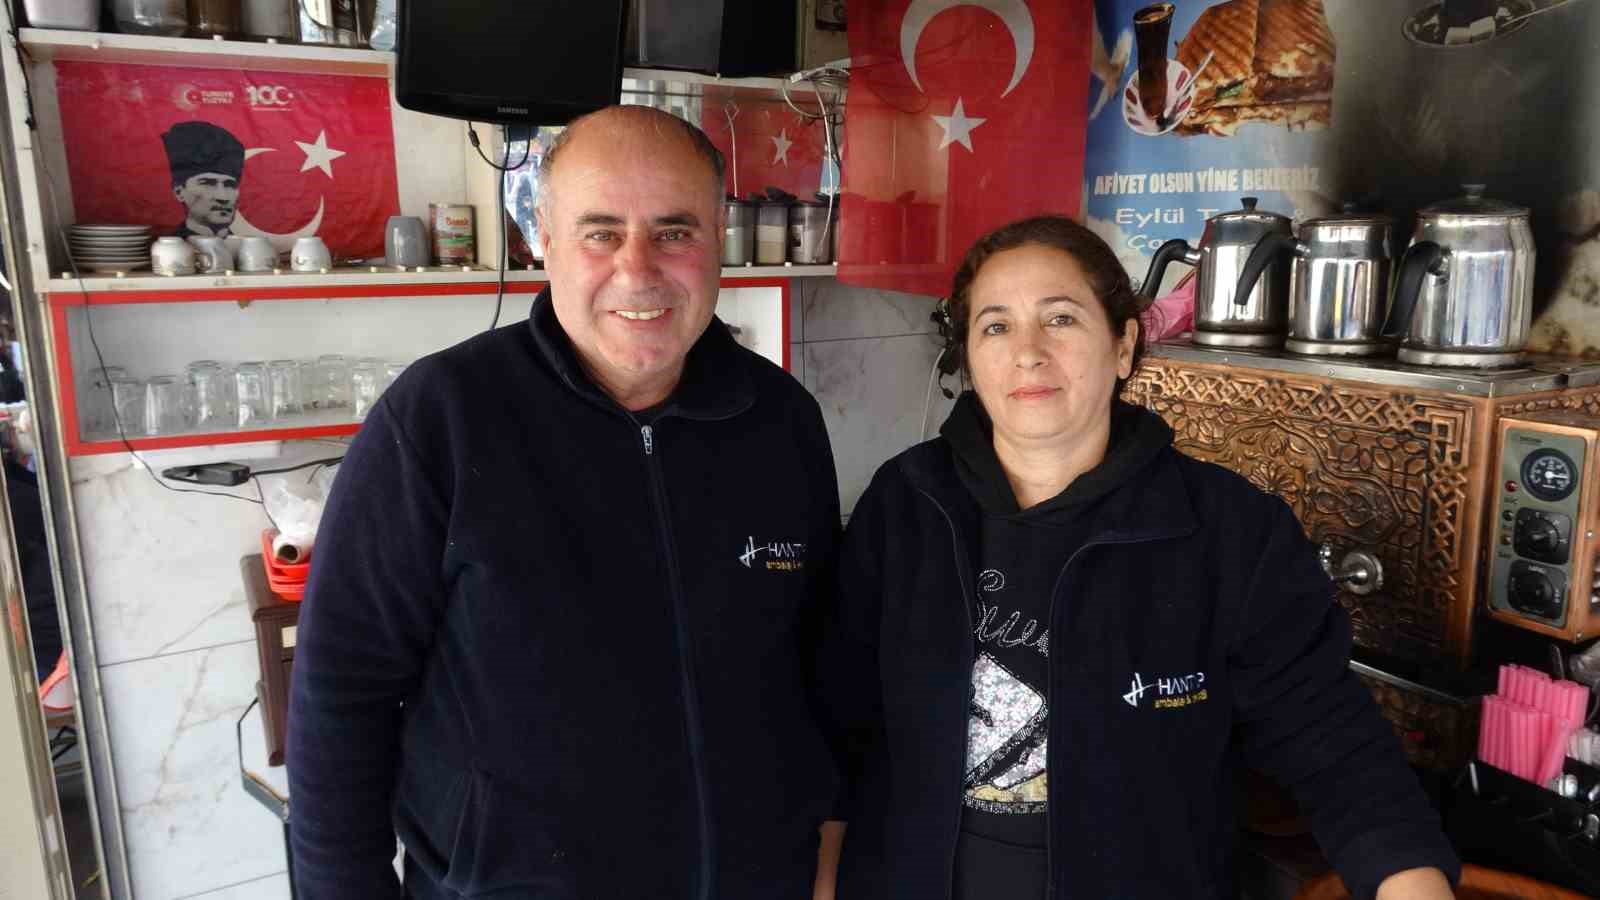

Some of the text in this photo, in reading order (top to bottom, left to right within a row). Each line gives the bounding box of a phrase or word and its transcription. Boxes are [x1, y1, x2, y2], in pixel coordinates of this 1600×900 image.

[1095, 172, 1147, 194] AFİYET
[1150, 171, 1194, 193] OLSUN
[1197, 168, 1238, 191] YİNE
[1115, 208, 1184, 228] Eylül
